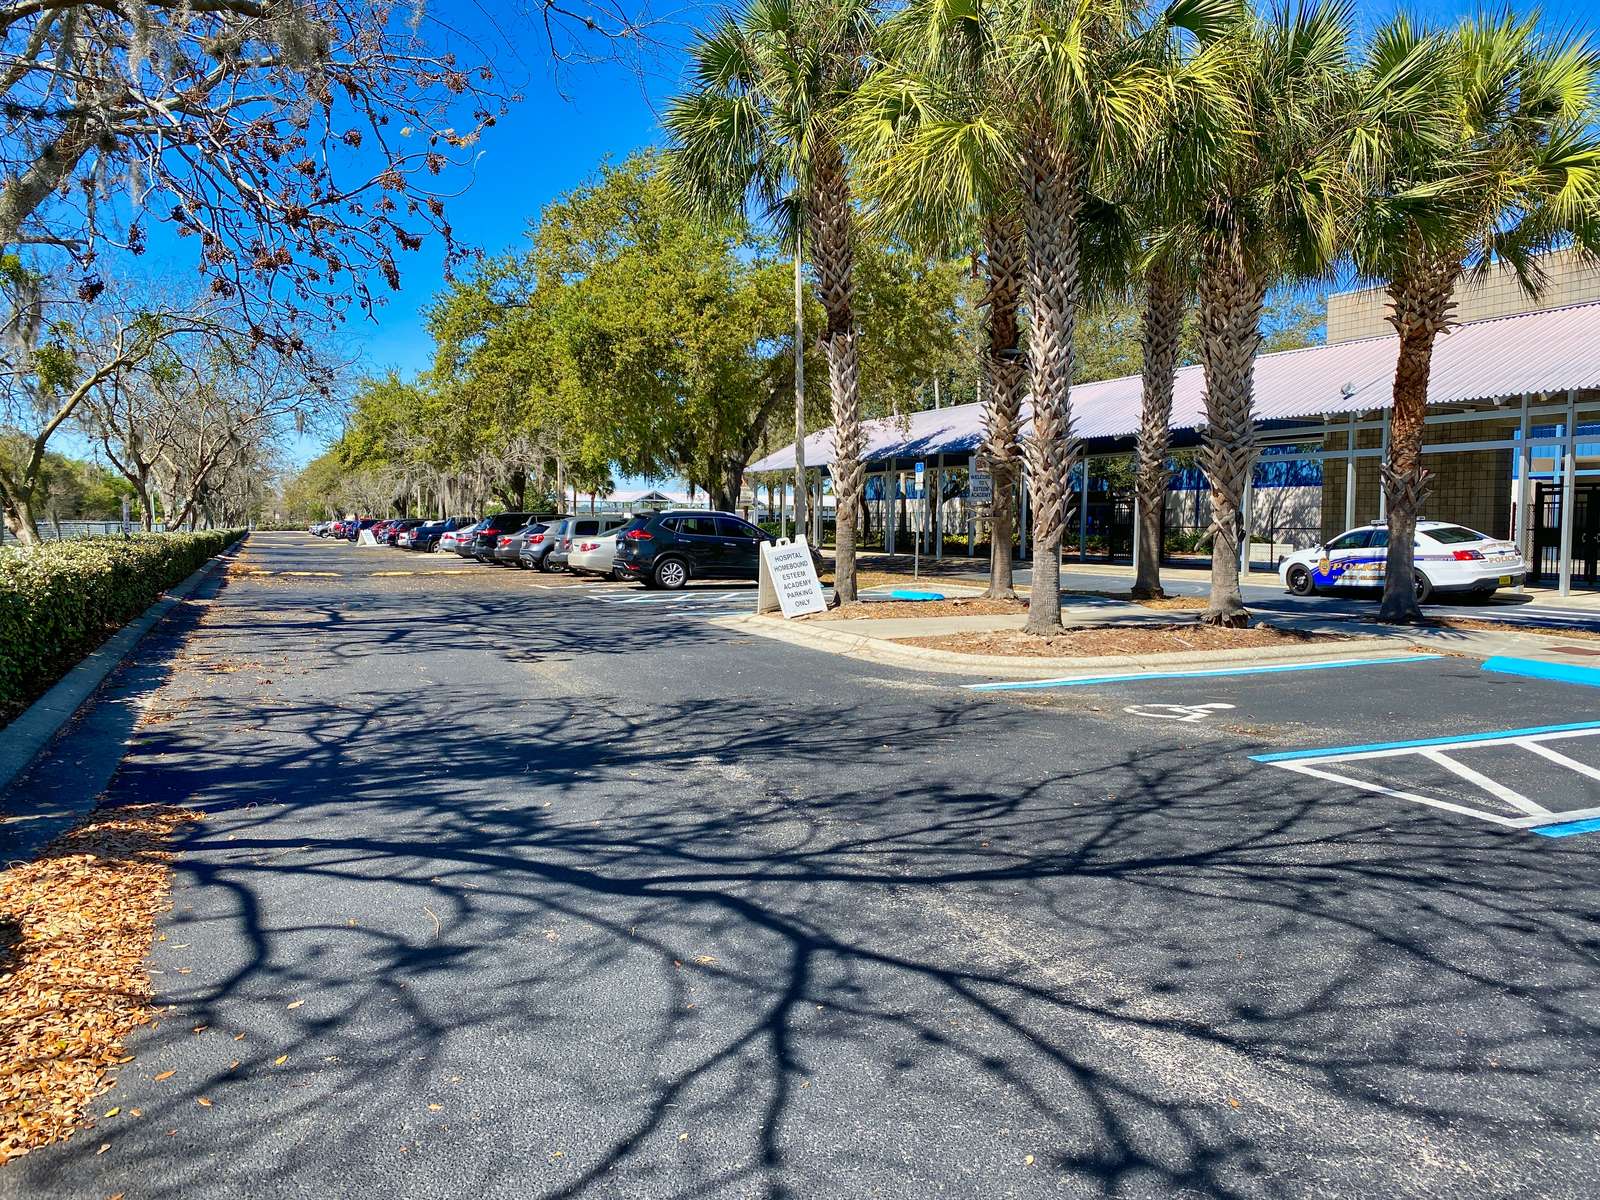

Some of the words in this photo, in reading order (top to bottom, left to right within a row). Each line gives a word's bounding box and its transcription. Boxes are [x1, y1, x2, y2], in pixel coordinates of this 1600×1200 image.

[774, 552, 803, 562] HOSPITAL
[1488, 555, 1517, 564] POLICE
[773, 560, 808, 572] HOMEBOUND
[782, 571, 806, 580] ESTEEM
[784, 580, 811, 590] ACADEMY
[786, 588, 813, 598] PARKING
[795, 599, 810, 607] ONLY
